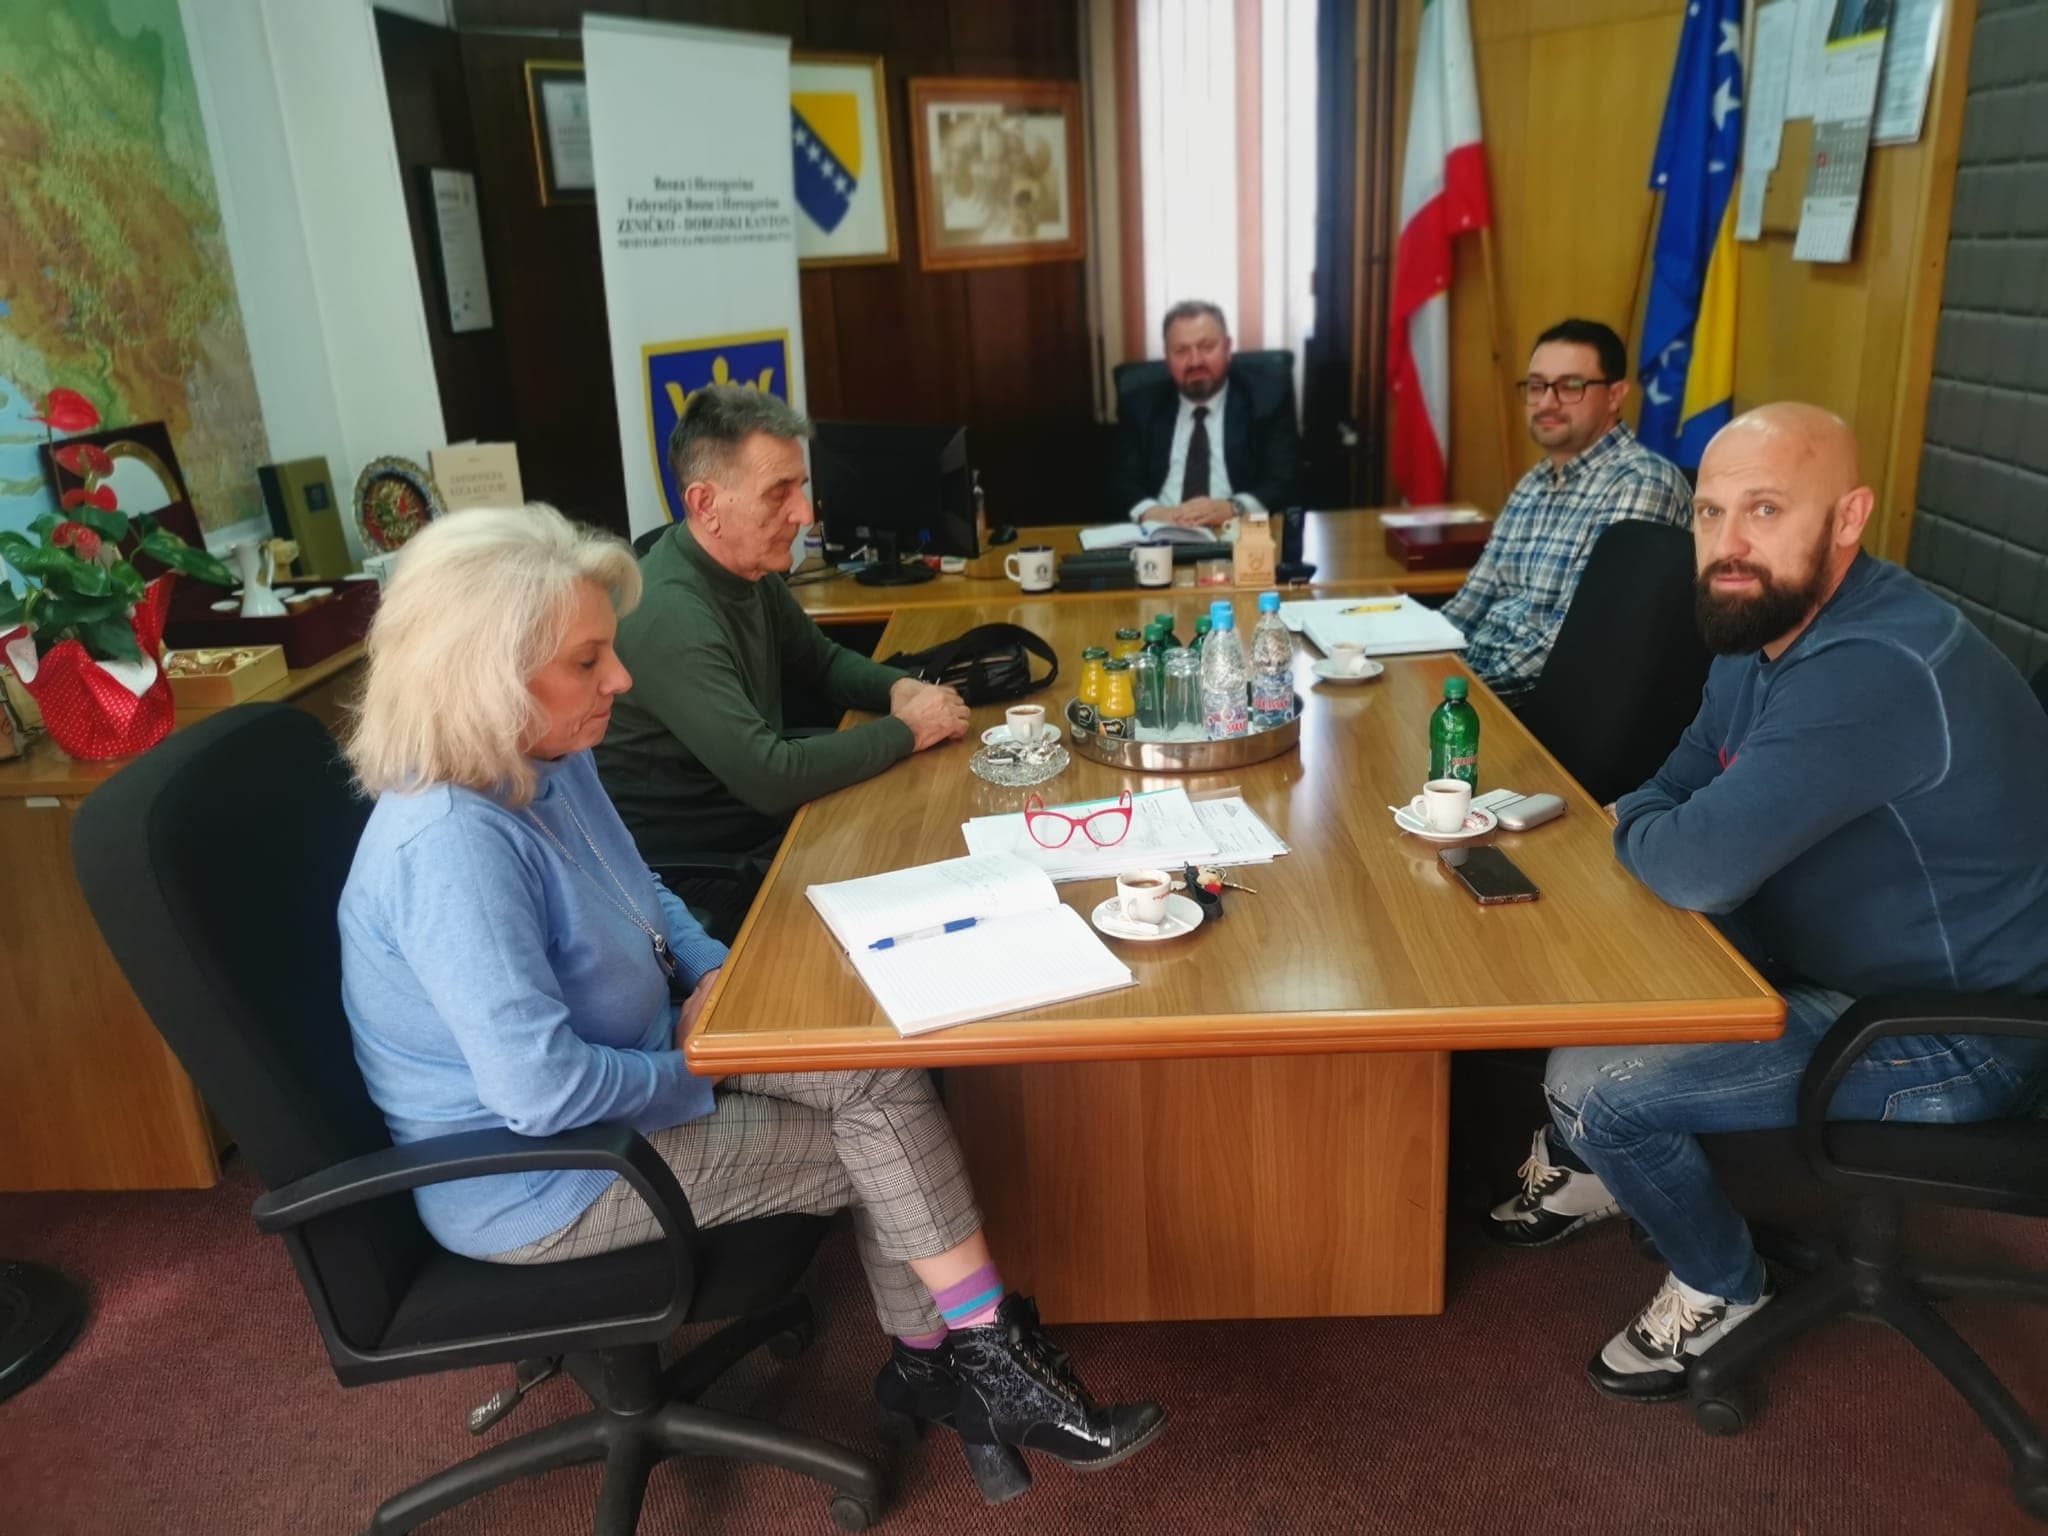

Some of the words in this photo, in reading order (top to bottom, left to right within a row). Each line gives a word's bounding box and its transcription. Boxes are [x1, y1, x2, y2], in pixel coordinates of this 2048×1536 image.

[617, 214, 675, 233] ZENIČKO
[684, 216, 742, 231] DOBOJSKI
[744, 215, 791, 230] KANTON
